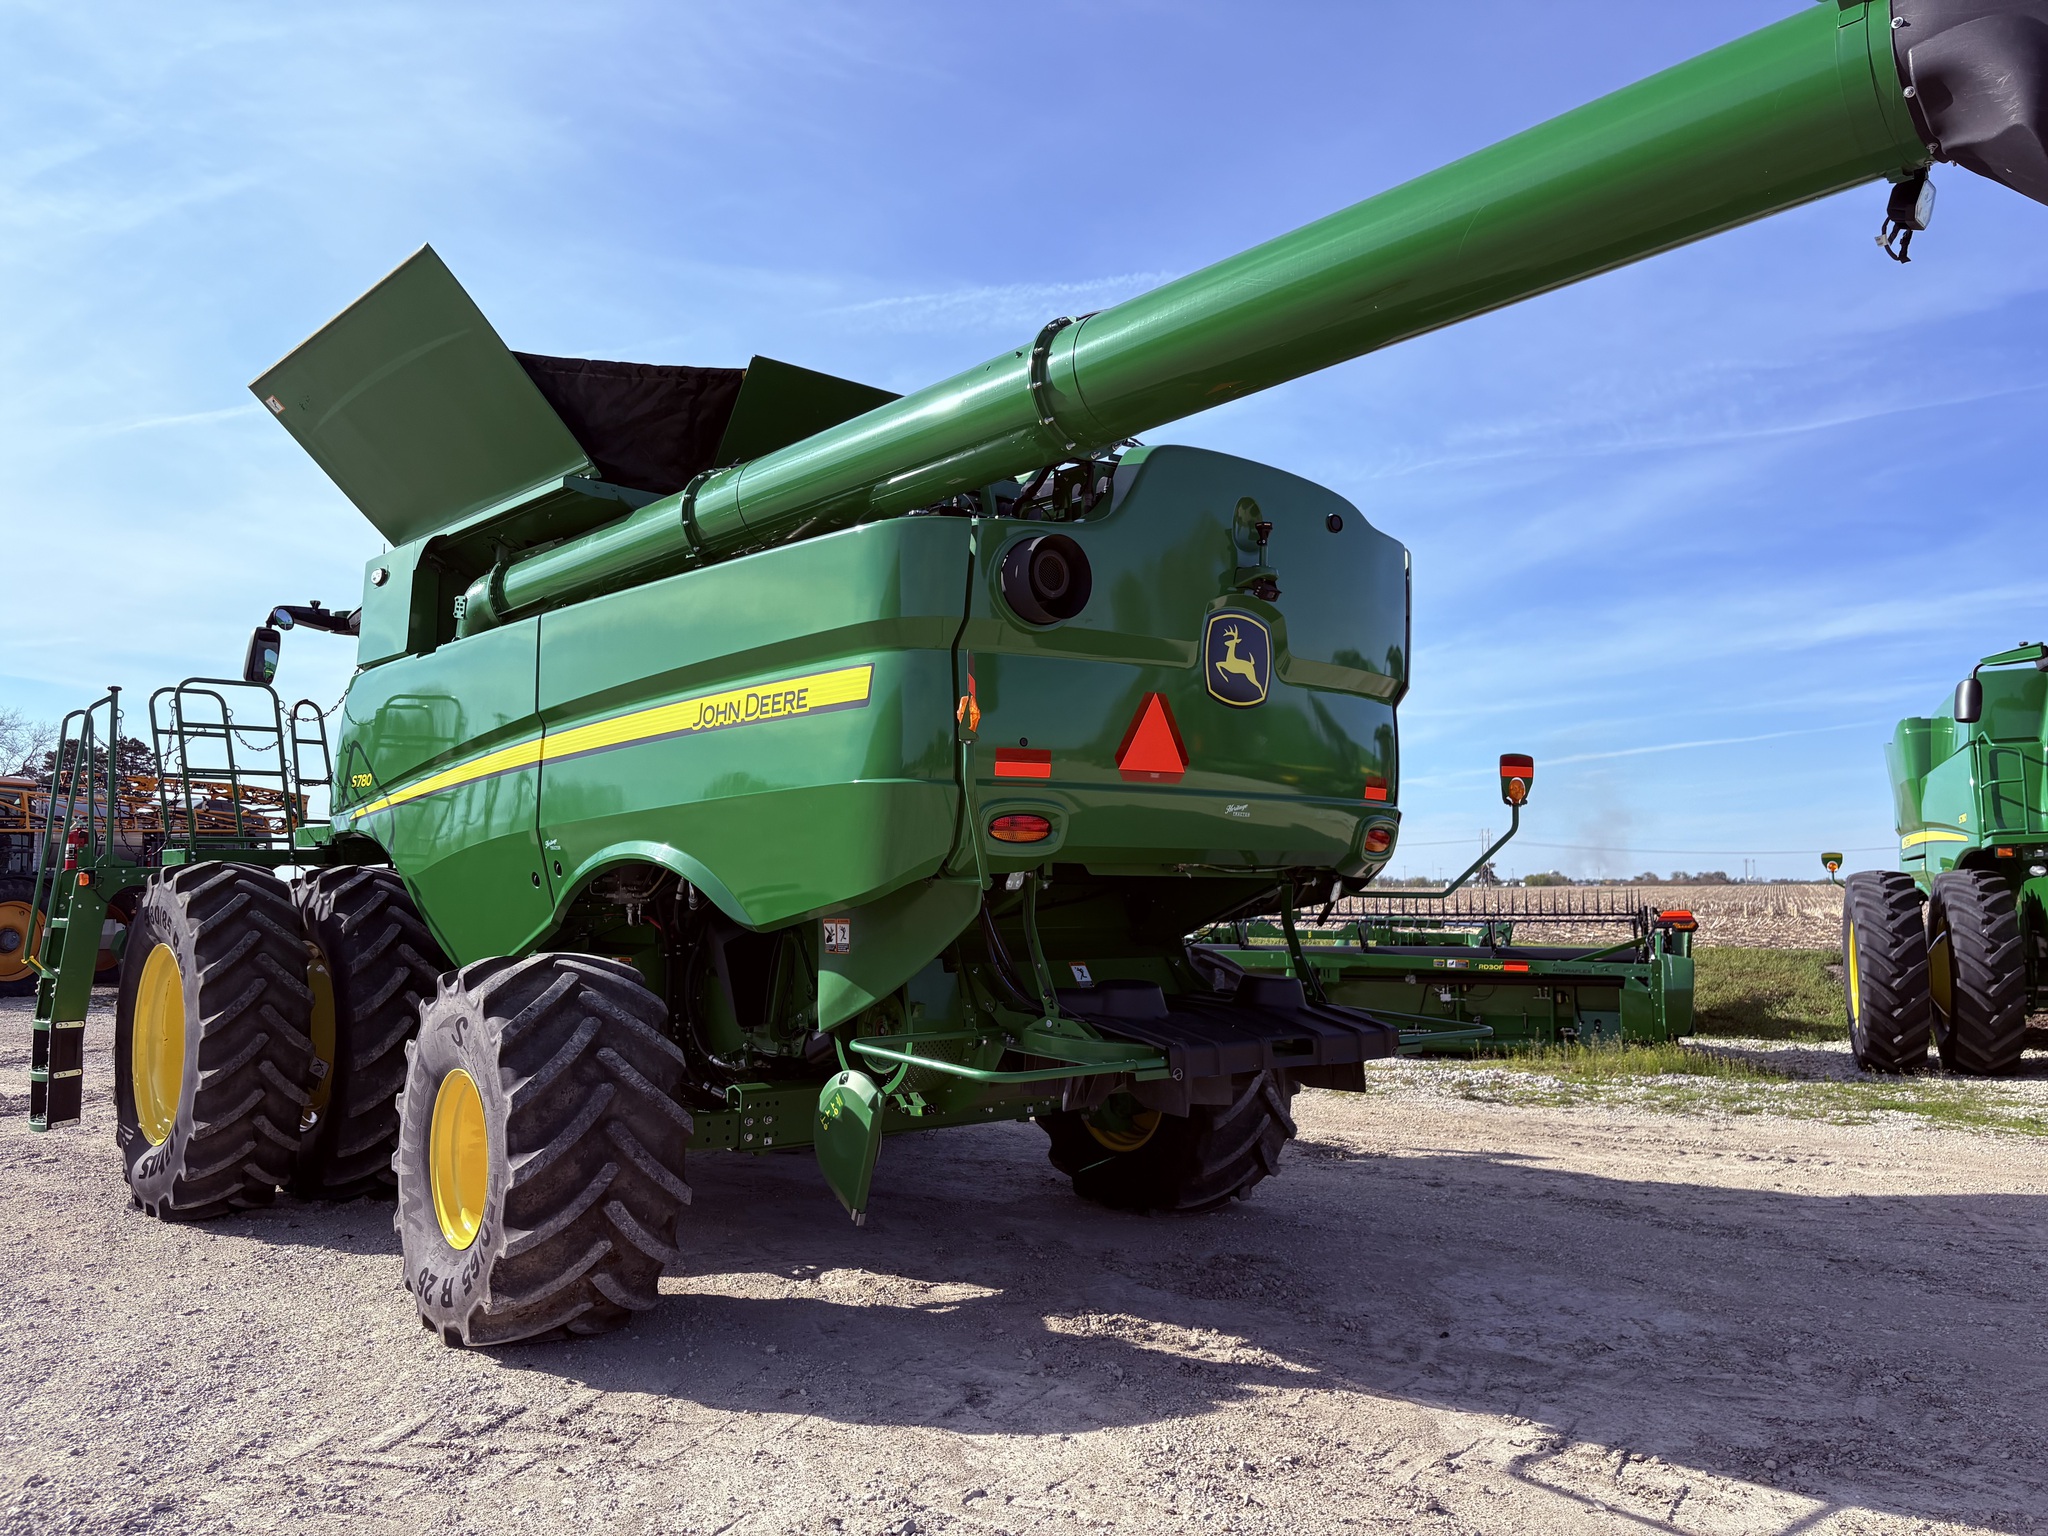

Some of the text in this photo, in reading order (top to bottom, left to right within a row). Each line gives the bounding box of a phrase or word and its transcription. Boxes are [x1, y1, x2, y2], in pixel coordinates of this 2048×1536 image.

[693, 688, 809, 727] JOHN DEERE
[352, 773, 373, 788] S780
[416, 1173, 499, 1308] 750/65 R 26
